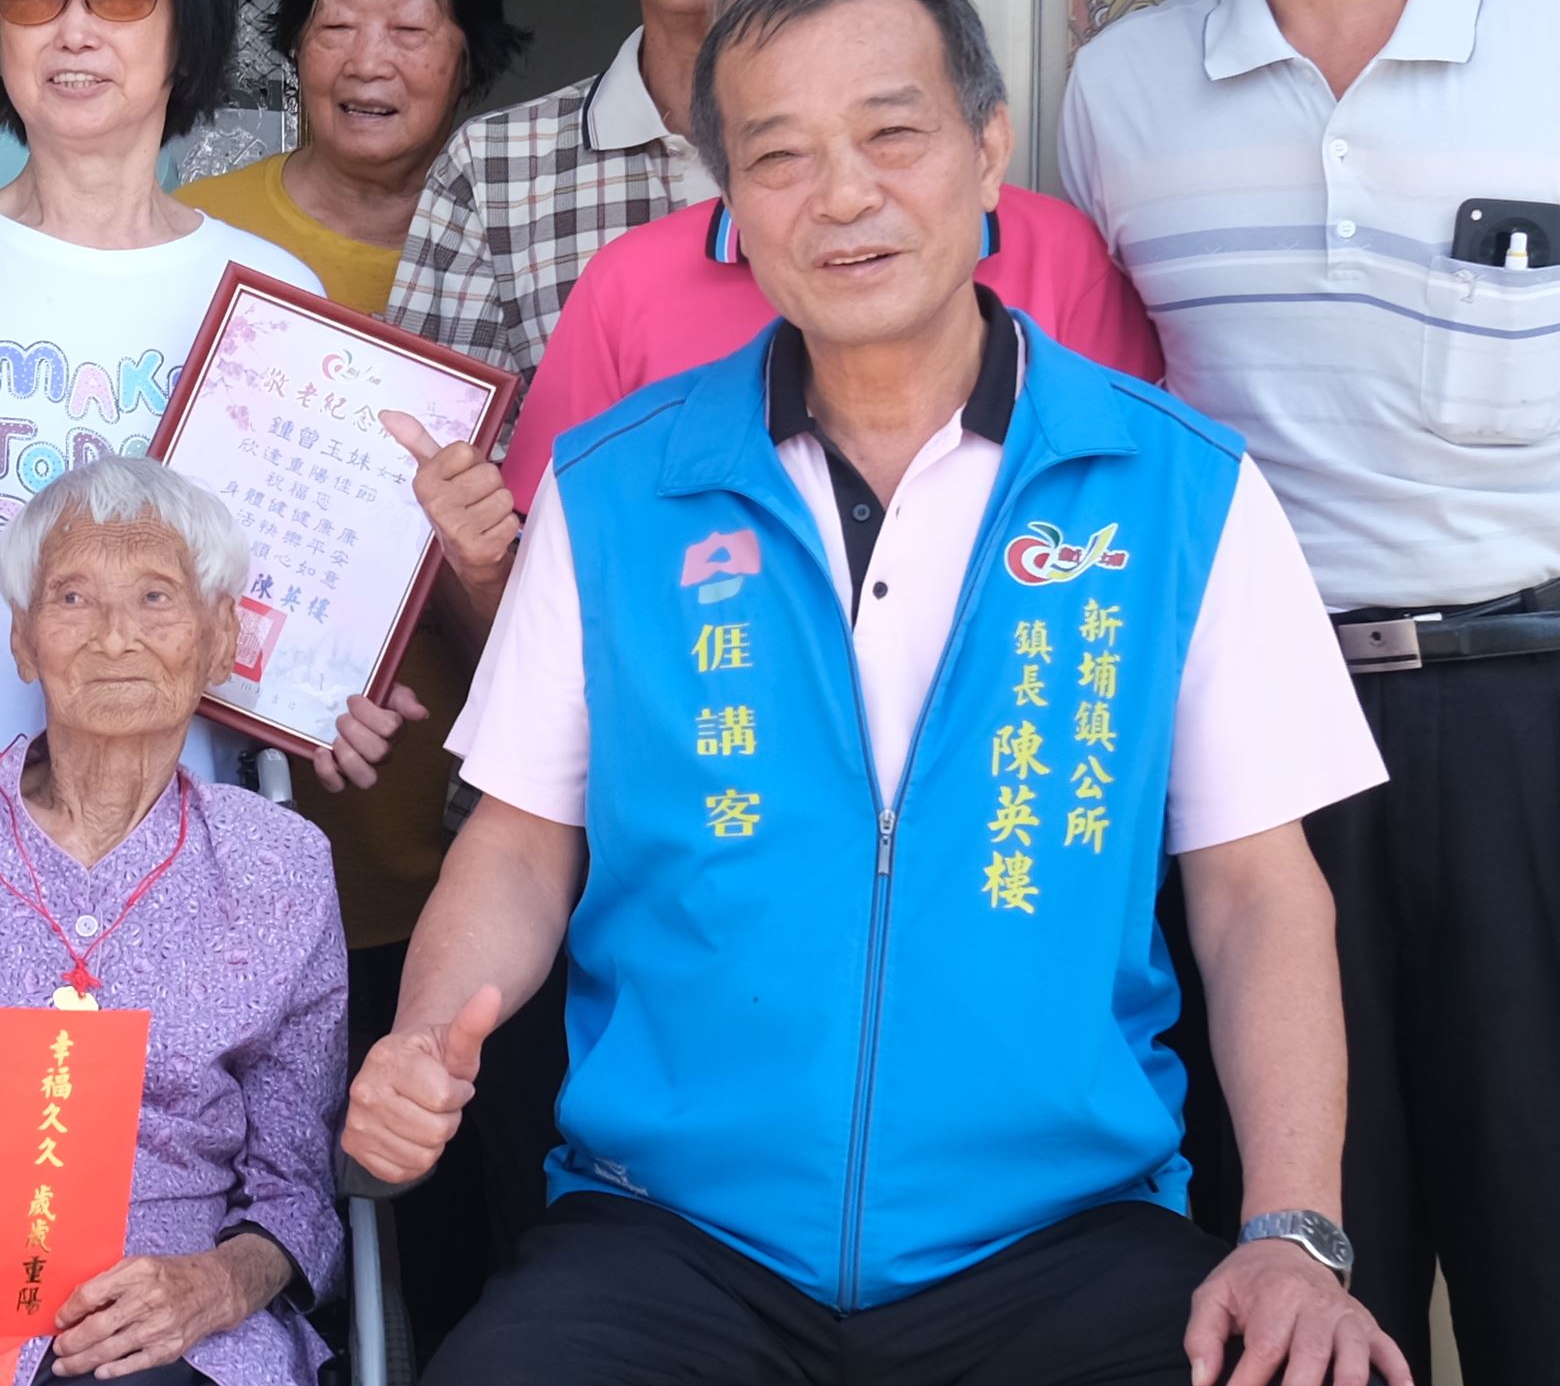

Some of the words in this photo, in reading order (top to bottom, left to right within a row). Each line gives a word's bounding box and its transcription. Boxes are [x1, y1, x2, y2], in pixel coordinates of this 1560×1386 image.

[262, 365, 394, 439] 敬老紀念
[234, 507, 351, 568] 活快樂平安
[1064, 597, 1124, 855] 新埔鎮公所
[33, 1028, 76, 1168] 幸福久久
[16, 1183, 58, 1316] 歲歲重陽
